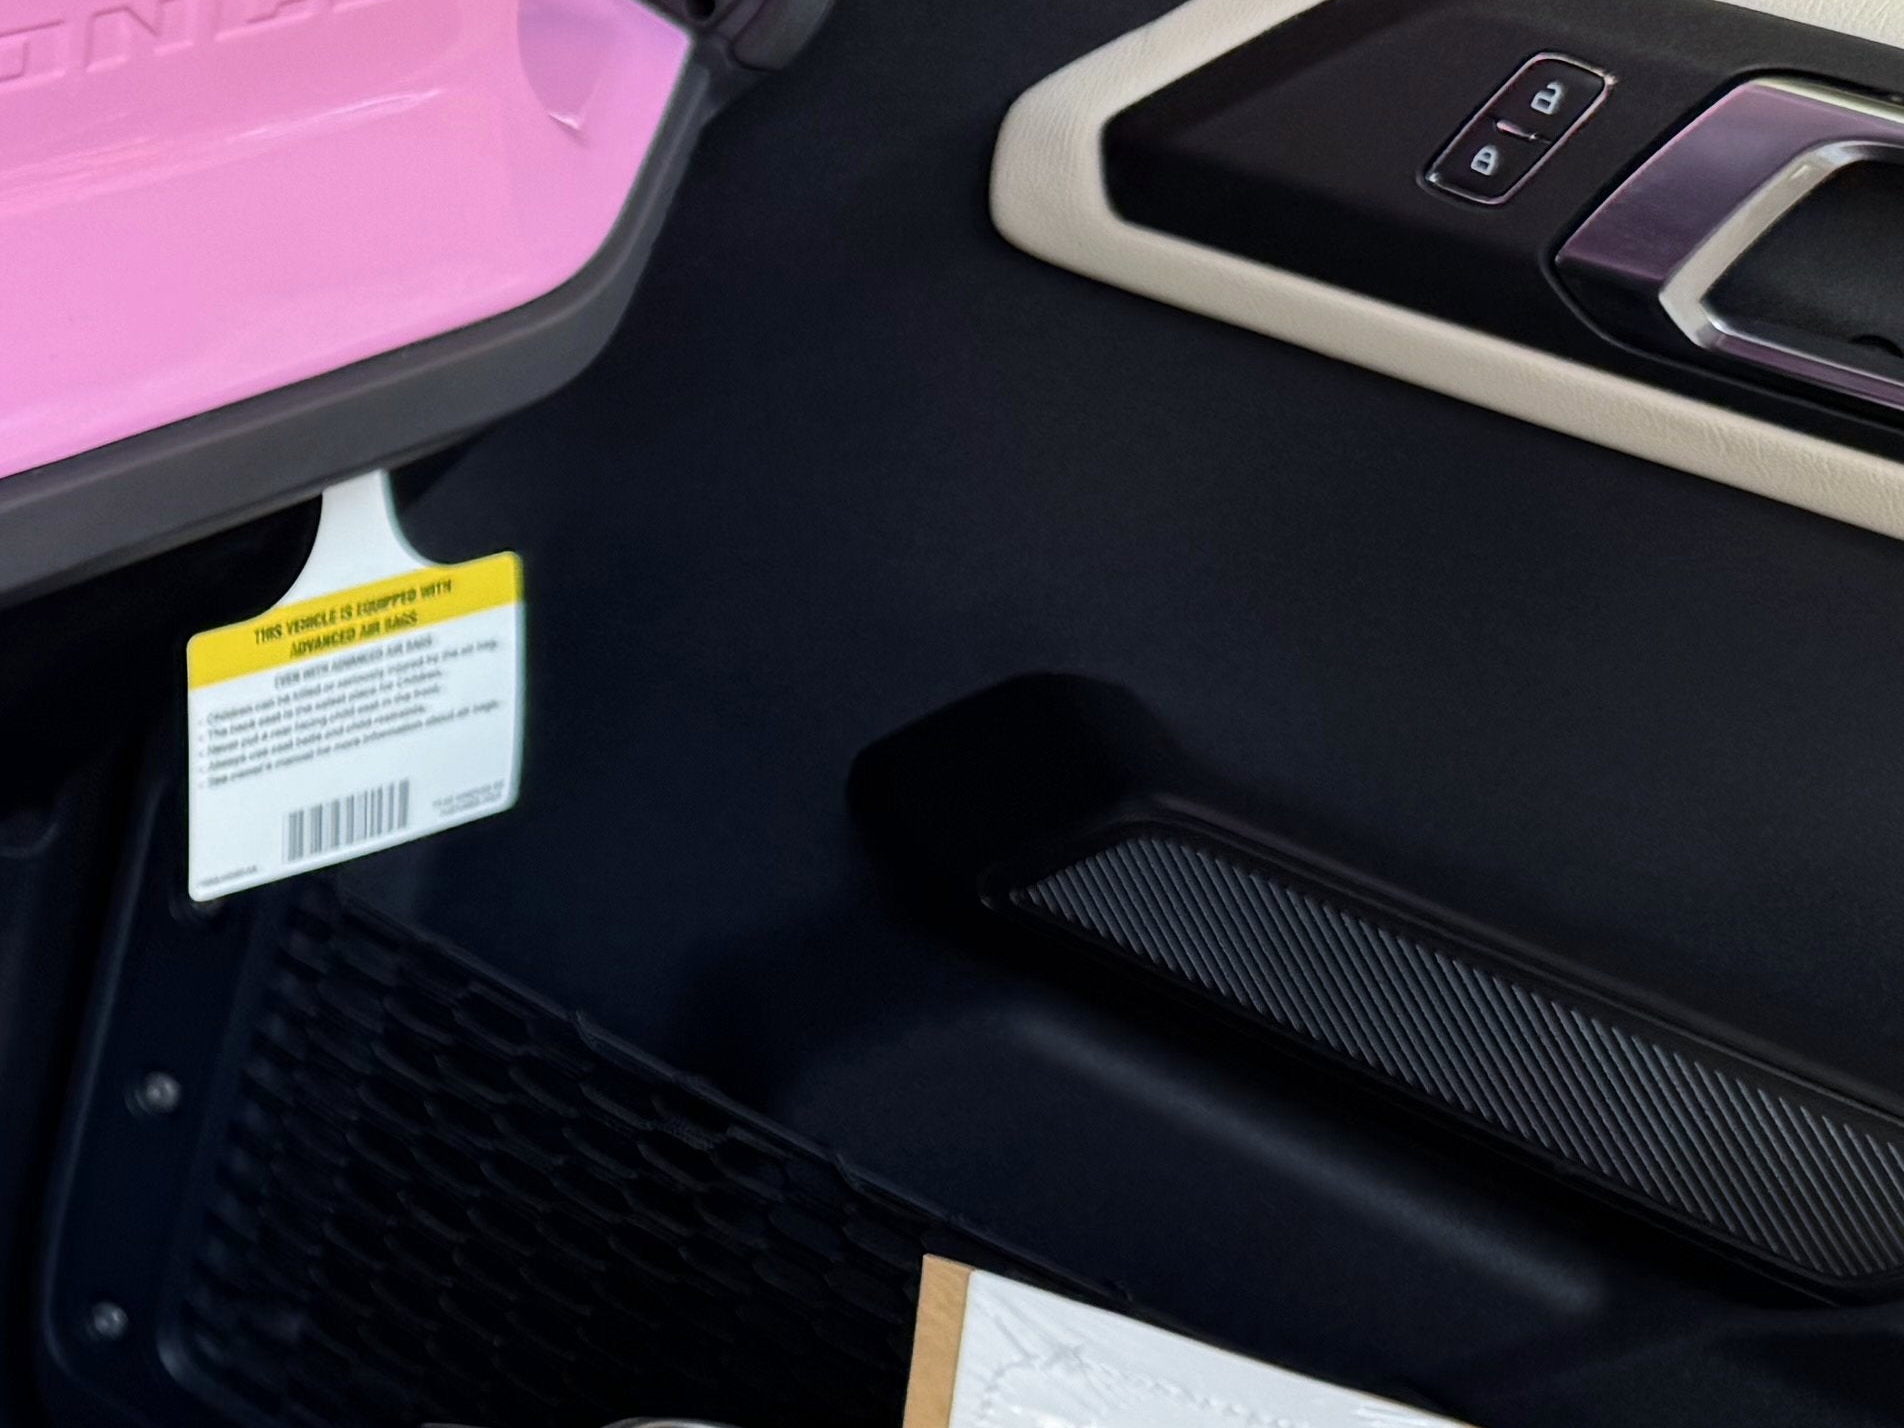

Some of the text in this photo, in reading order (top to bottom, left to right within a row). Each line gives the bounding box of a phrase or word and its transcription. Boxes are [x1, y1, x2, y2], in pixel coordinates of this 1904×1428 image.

[254, 579, 451, 645] THIS VEHICLE IS EQUIPPED WITH
[289, 610, 417, 658] ADVANCED AIR BAGS
